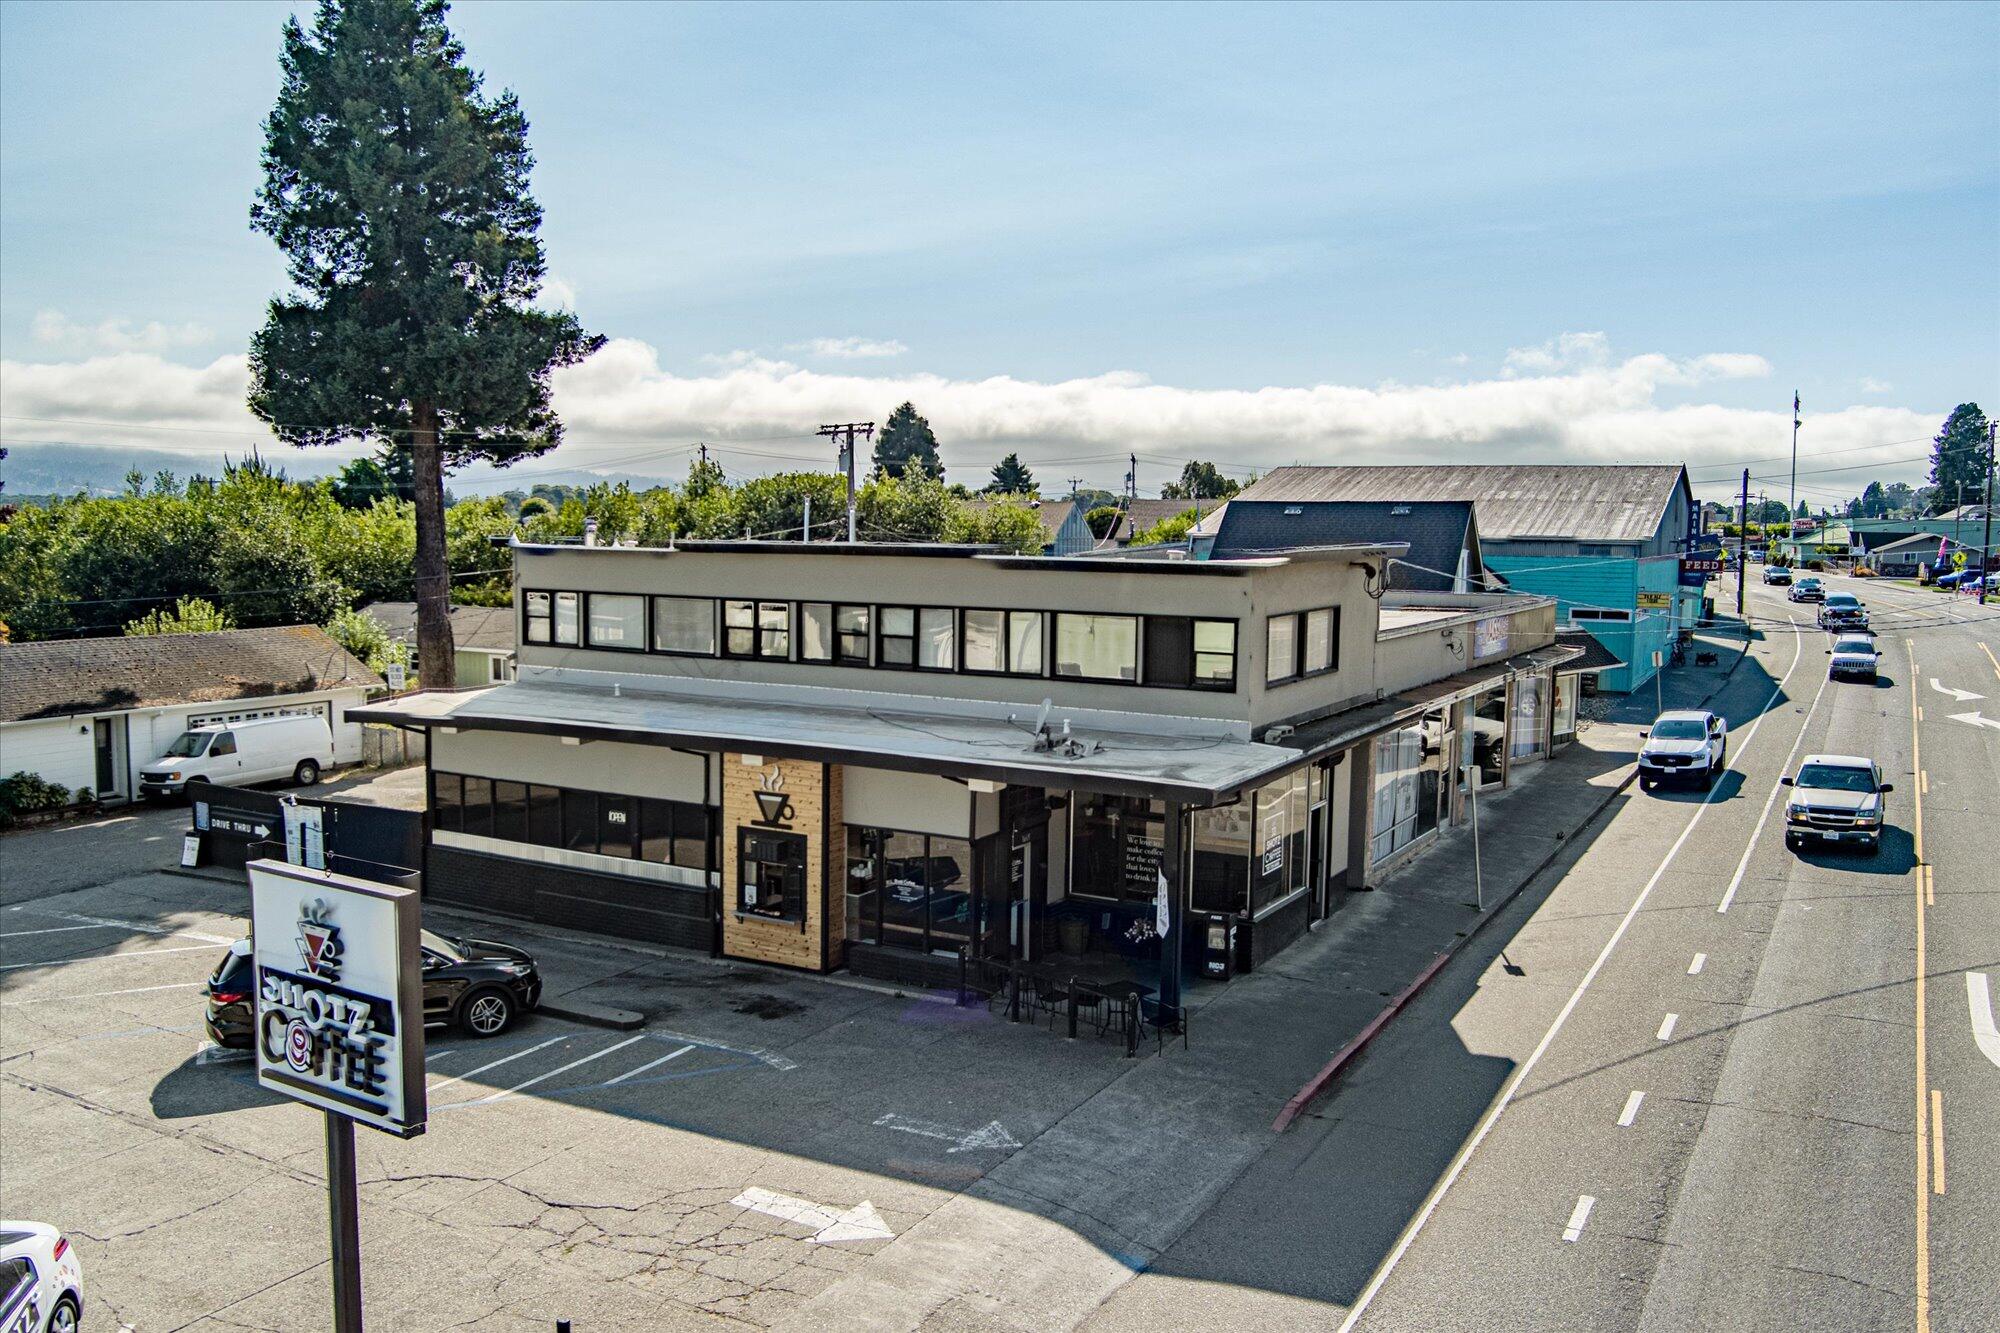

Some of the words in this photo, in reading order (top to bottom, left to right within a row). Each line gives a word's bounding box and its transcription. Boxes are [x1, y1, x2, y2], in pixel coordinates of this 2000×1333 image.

[1685, 560, 1719, 570] FEED
[608, 810, 626, 823] OPEN
[212, 818, 230, 829] DRIVE
[233, 822, 251, 833] THRU
[1127, 836, 1138, 845] We
[1139, 838, 1152, 847] love
[1126, 846, 1142, 854] make
[1143, 848, 1163, 856] coffee
[1136, 855, 1145, 863] the
[1147, 857, 1159, 866] city
[1139, 864, 1155, 873] loves
[1133, 873, 1150, 882] drink
[262, 974, 373, 1044] SHOTZ
